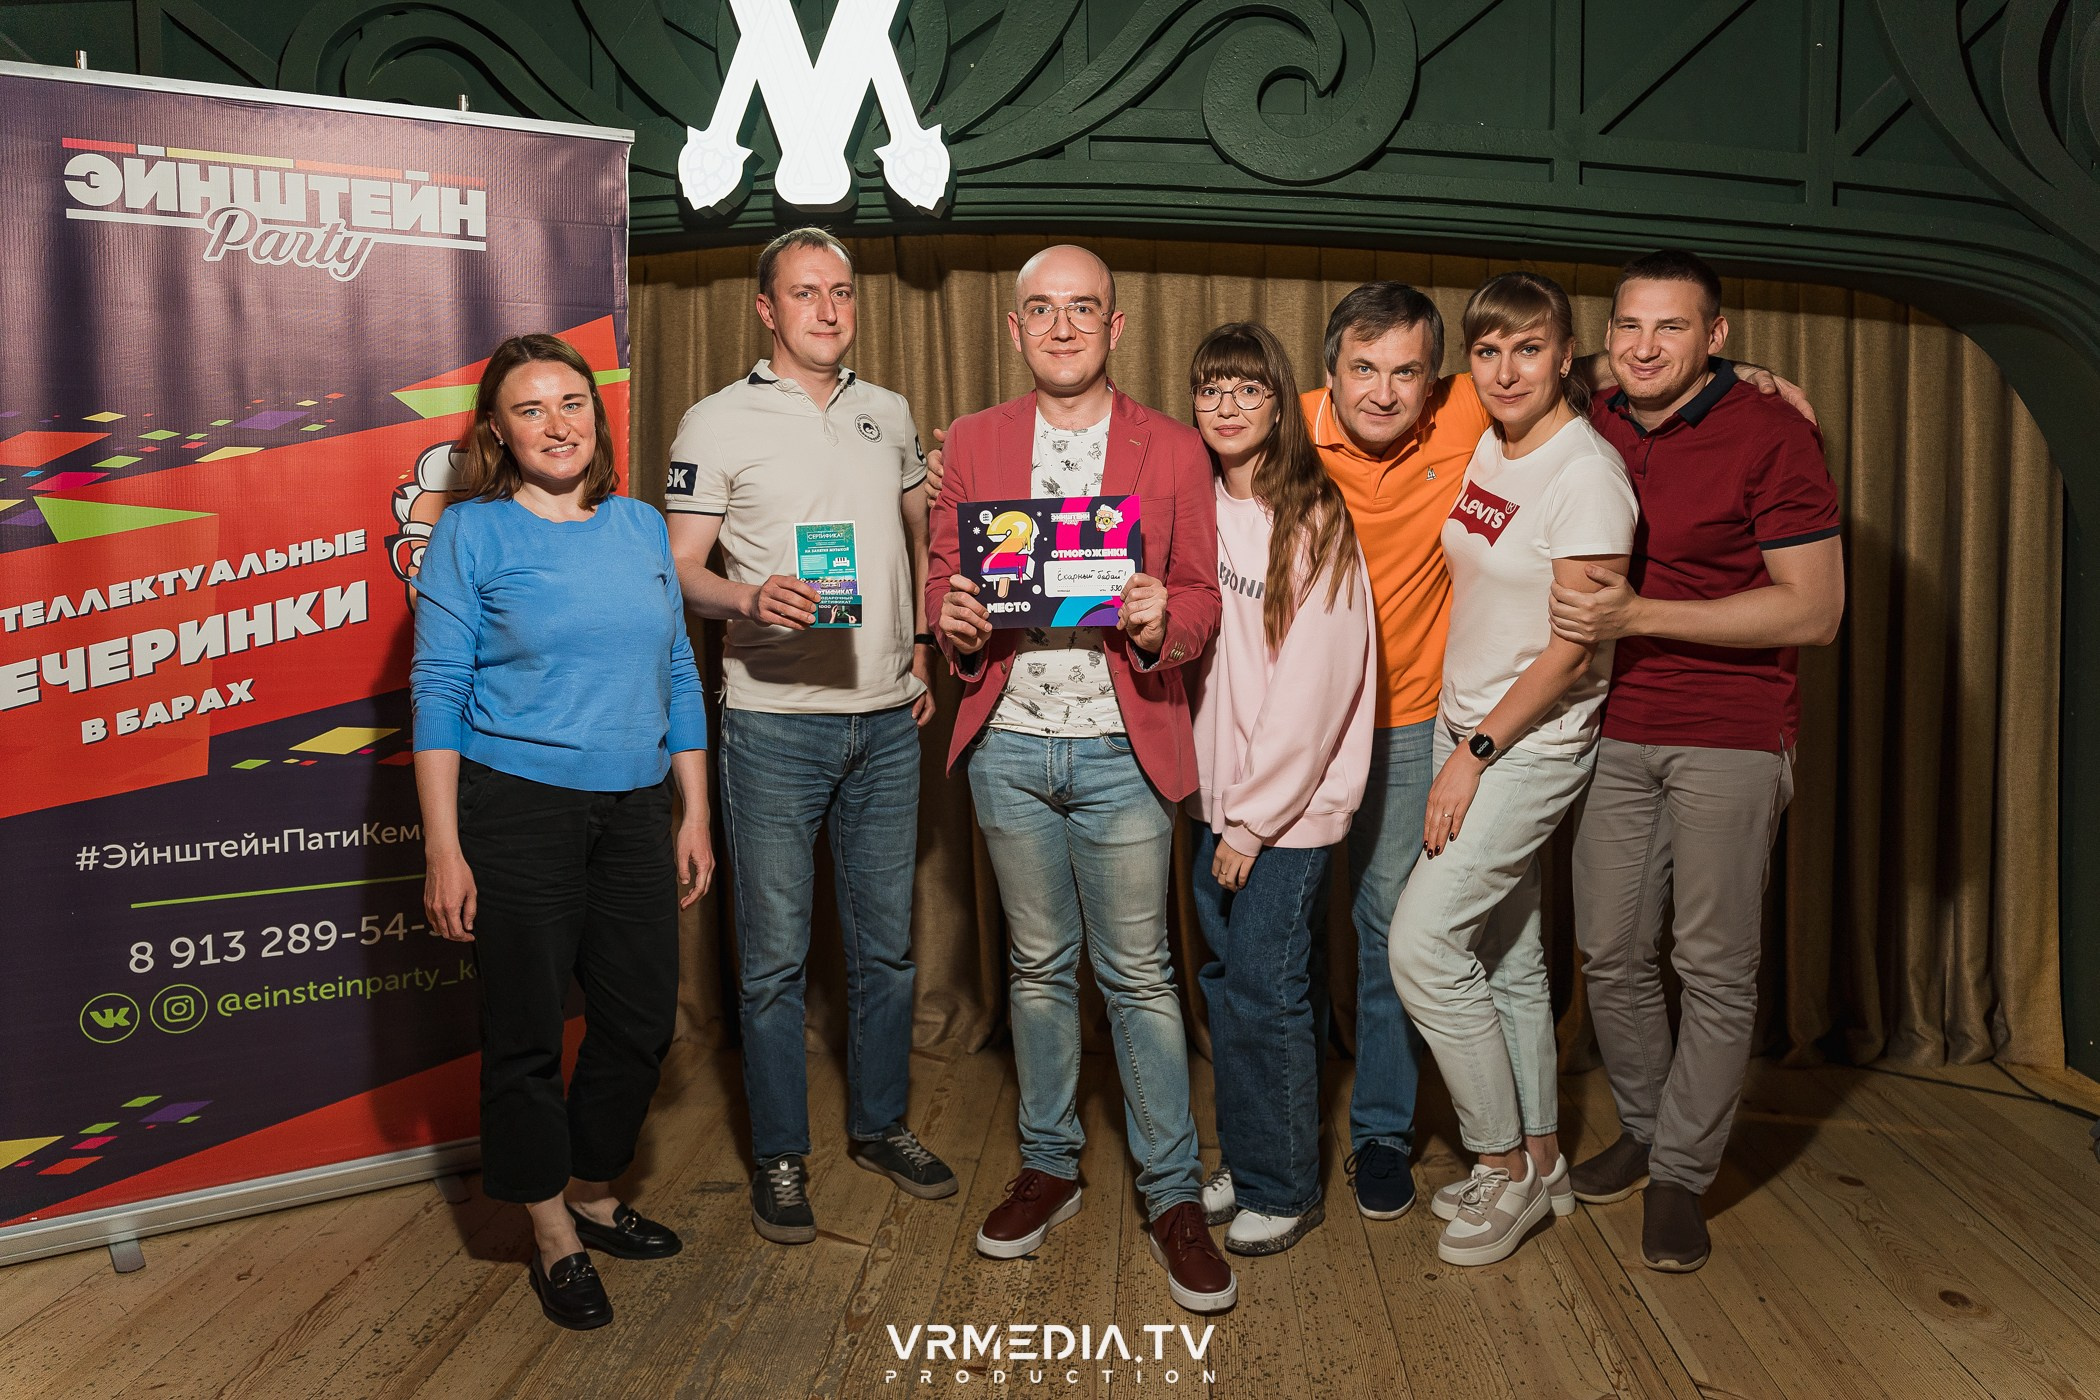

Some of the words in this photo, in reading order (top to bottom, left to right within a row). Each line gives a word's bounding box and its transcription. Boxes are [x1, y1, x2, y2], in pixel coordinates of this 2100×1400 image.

[63, 145, 487, 238] ЭЙНШТЕЙН
[203, 207, 377, 282] Party
[981, 511, 1037, 582] 2
[1051, 548, 1127, 558] ОТМОРОЖЕНКИ
[986, 601, 1031, 613] МЕСТО
[81, 717, 107, 744] В
[117, 678, 255, 736] БАРАХ
[75, 822, 426, 872] #ЭйнштейнПатиКем
[129, 941, 155, 974] 8
[170, 930, 247, 969] 913
[261, 912, 443, 959] 289-54-
[216, 959, 478, 1018] @einsteinparty_k
